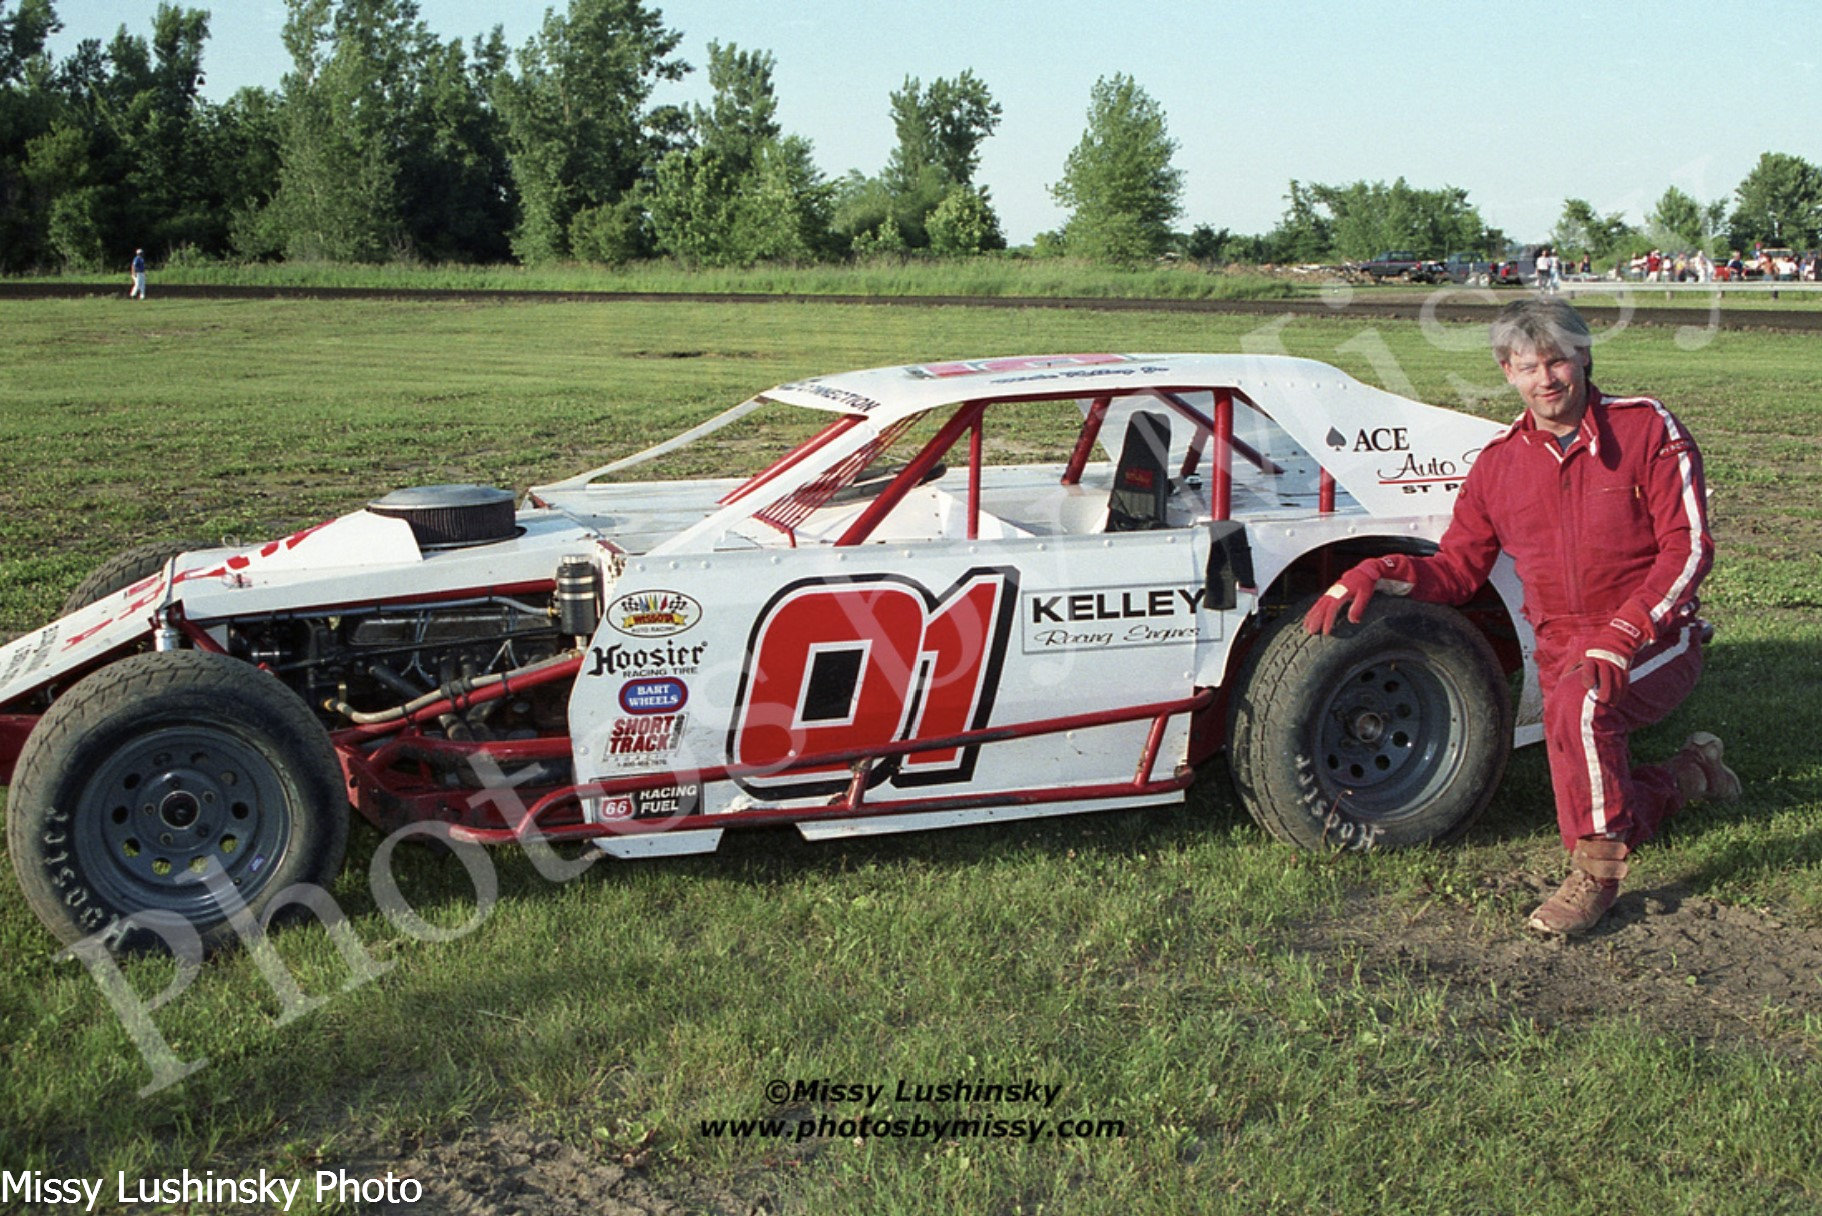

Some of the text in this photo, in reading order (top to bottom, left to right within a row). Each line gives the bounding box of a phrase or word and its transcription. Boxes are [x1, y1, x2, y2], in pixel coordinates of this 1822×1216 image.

[1353, 427, 1410, 451] ACE
[1377, 452, 1457, 480] Auto
[1402, 484, 1432, 494] ST
[1033, 588, 1206, 624] KELLEY
[623, 666, 698, 677] RACING TIRE
[637, 684, 670, 695] BART
[726, 564, 1021, 801] 01
[628, 695, 679, 706] WHEELS
[612, 715, 675, 736] SHORT
[609, 733, 670, 754] TRACK
[640, 785, 697, 800] RACING
[605, 801, 627, 815] 66
[640, 800, 679, 814] FUEL
